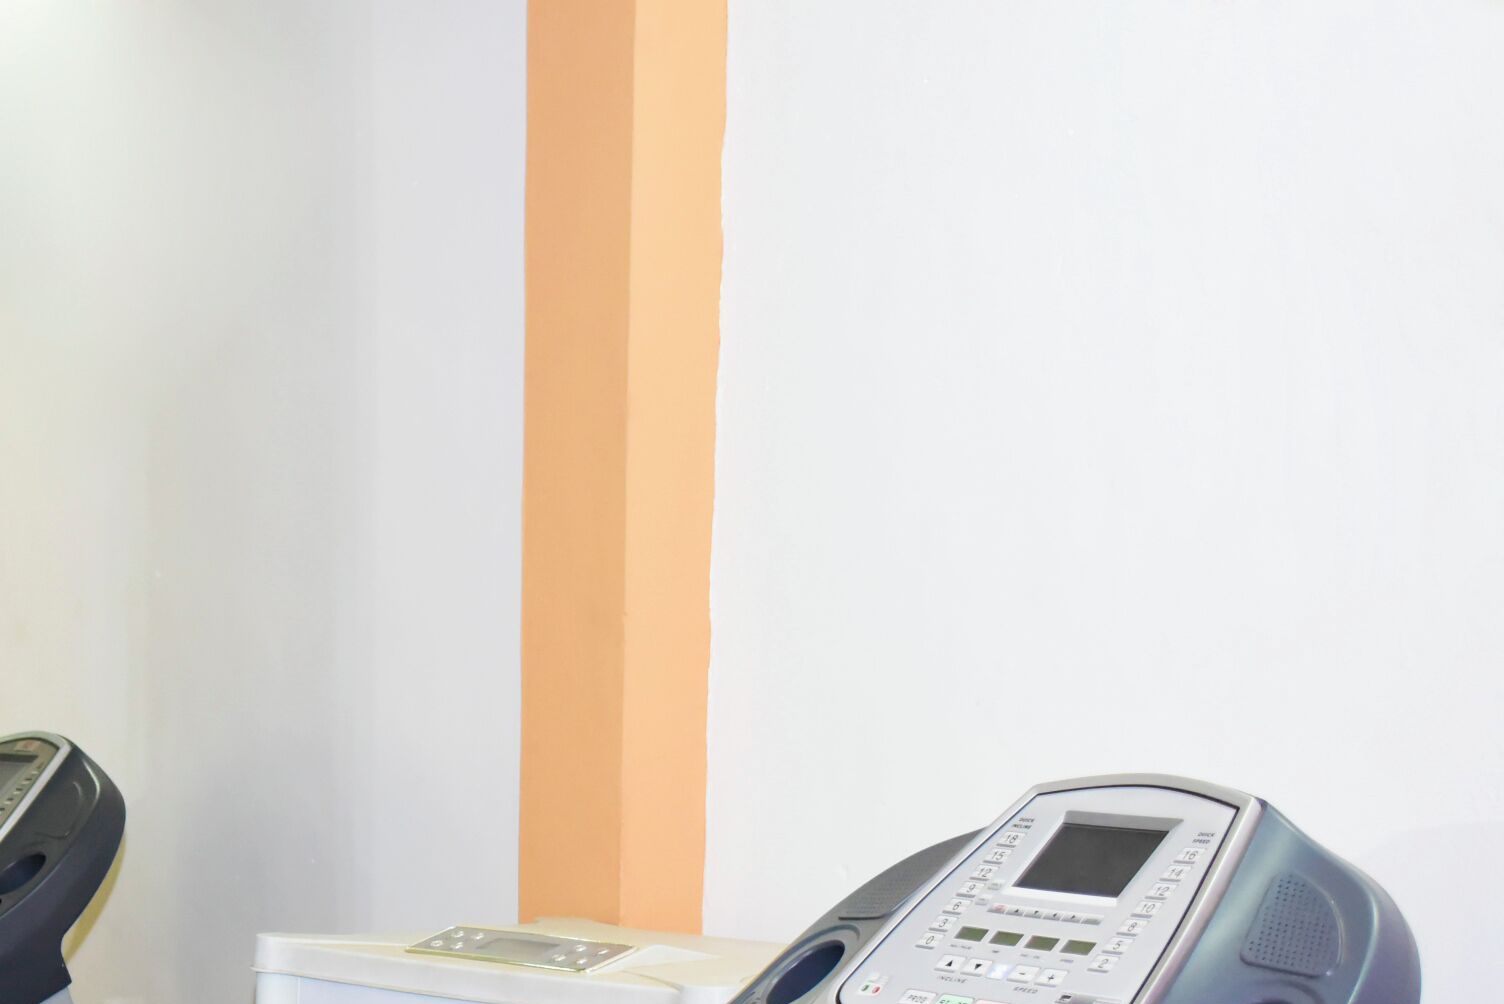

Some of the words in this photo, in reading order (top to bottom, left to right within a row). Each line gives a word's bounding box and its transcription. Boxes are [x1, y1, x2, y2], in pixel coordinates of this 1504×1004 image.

[1006, 834, 1018, 844] 18
[993, 850, 1005, 861] 15
[1183, 850, 1199, 860] 16
[979, 867, 993, 878] 12
[1169, 868, 1184, 878] 14
[1156, 886, 1170, 896] 12
[1141, 903, 1156, 914] 10
[1097, 958, 1109, 969] 2
